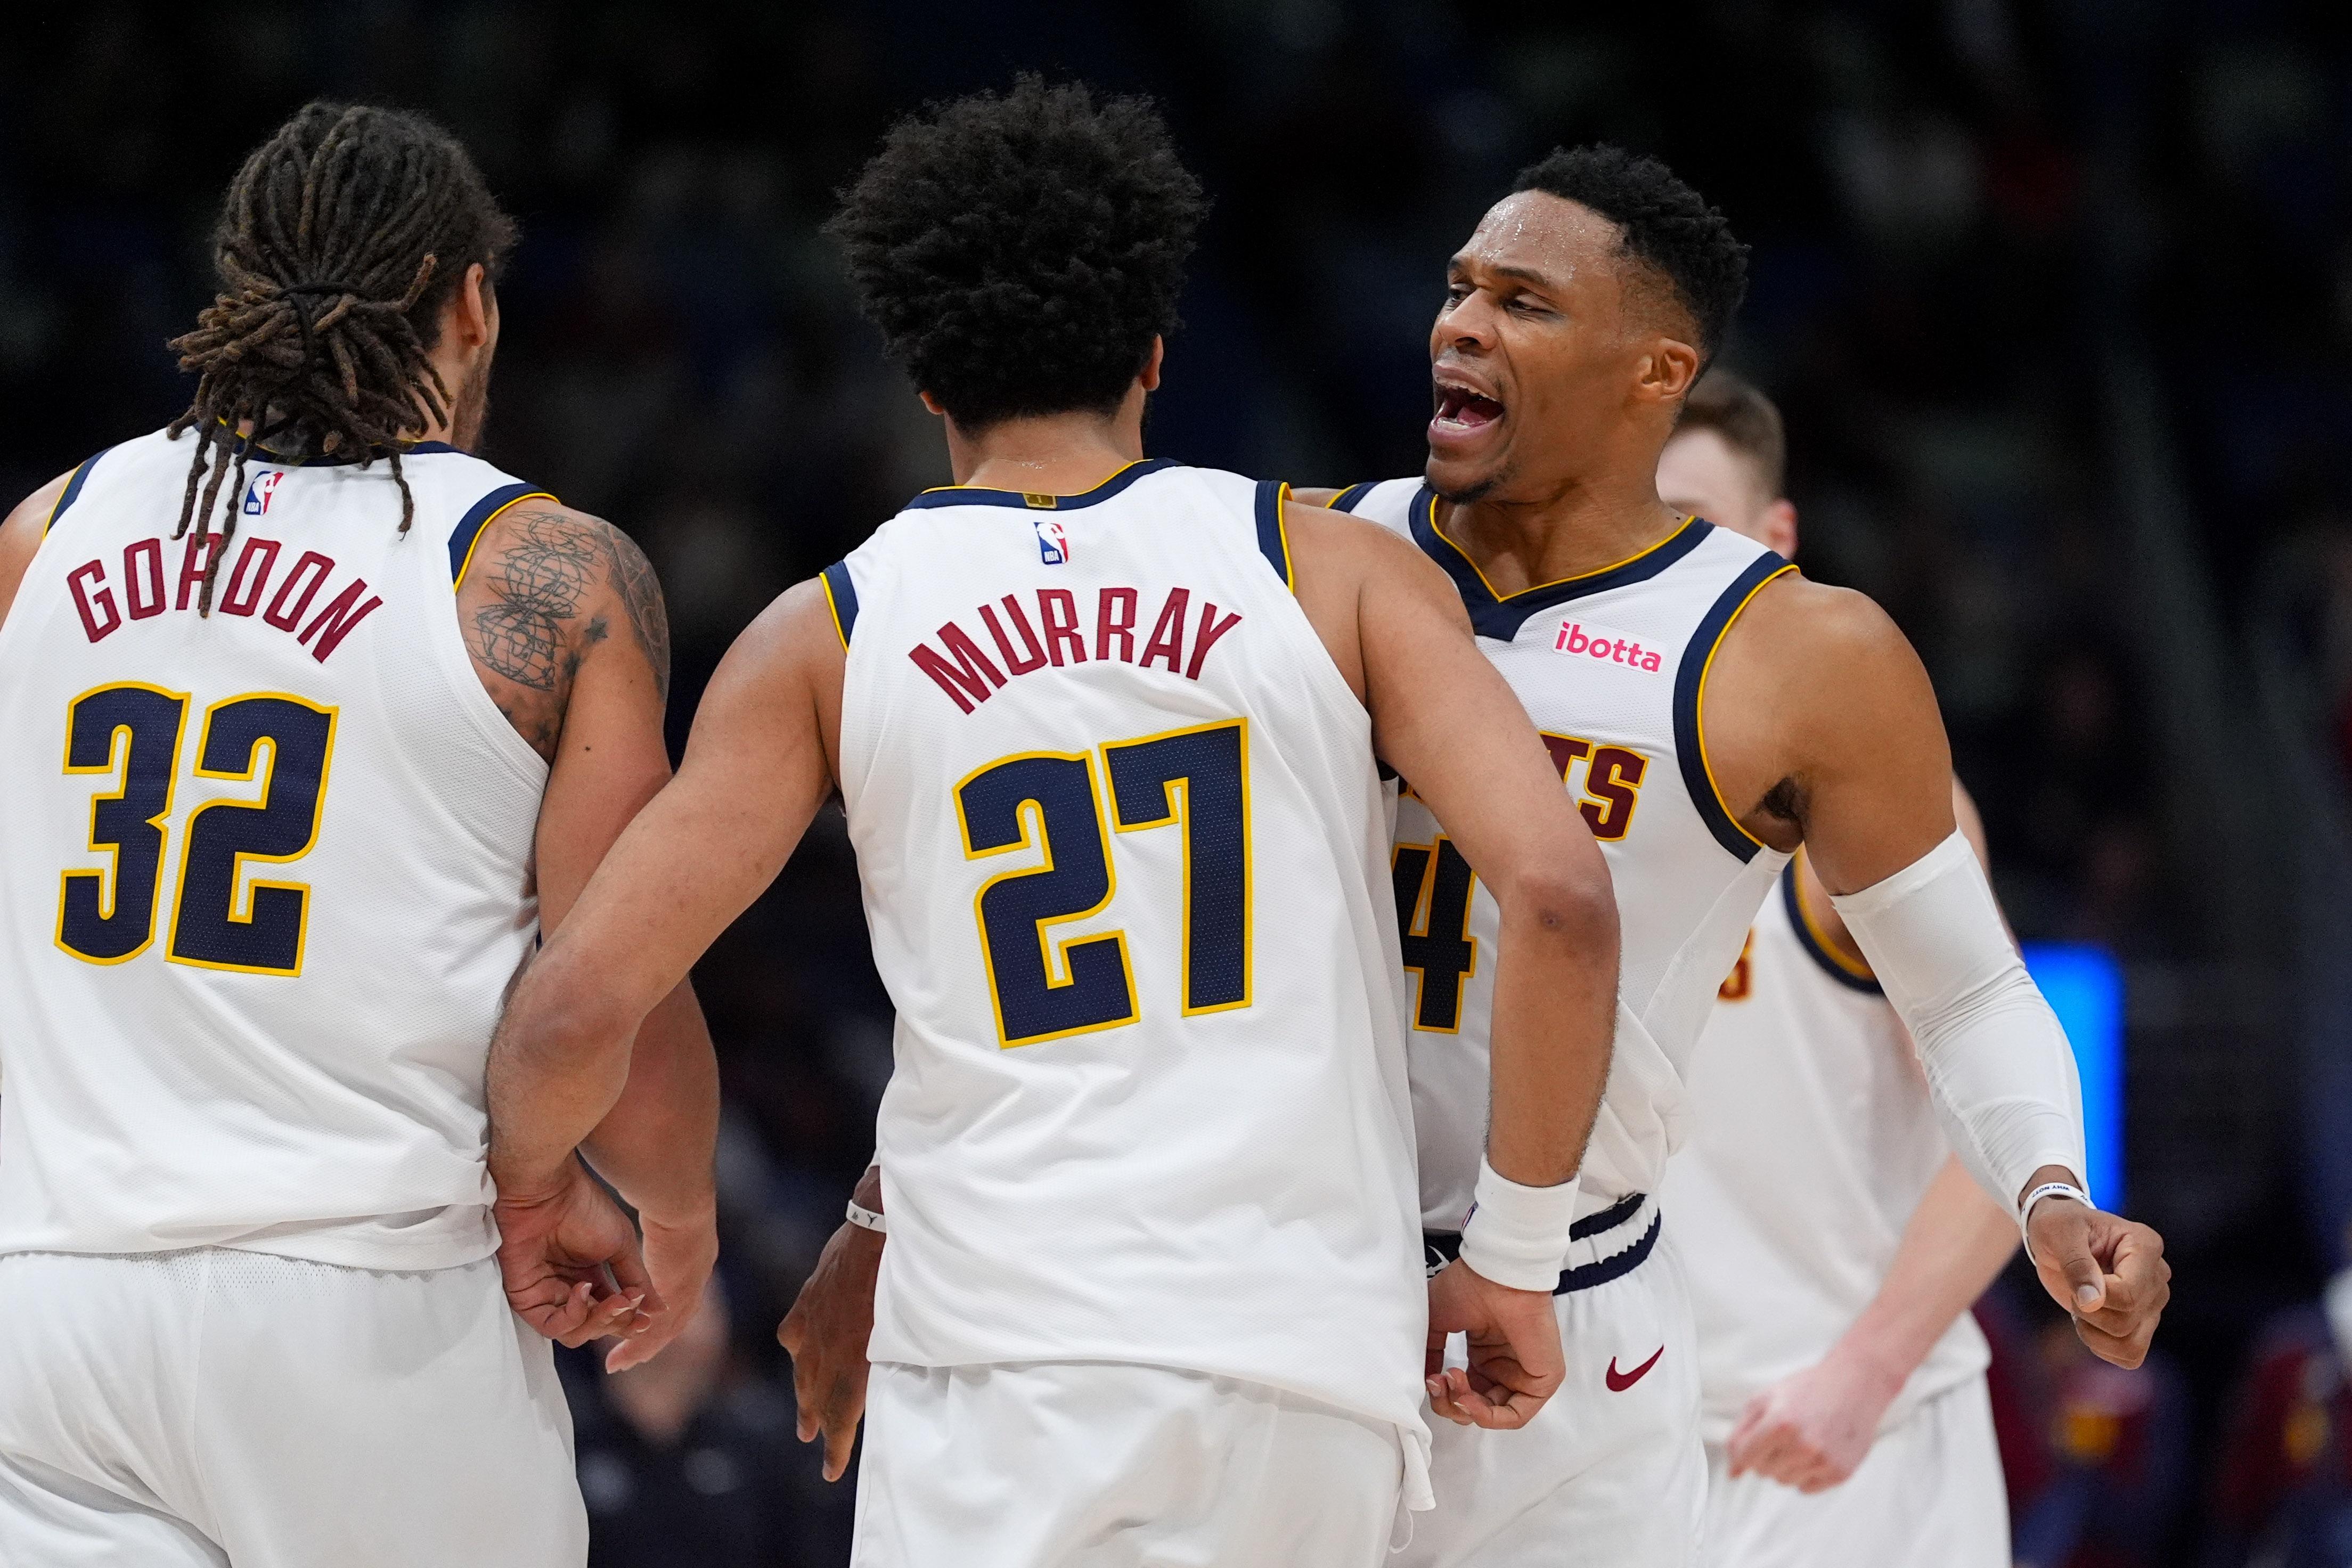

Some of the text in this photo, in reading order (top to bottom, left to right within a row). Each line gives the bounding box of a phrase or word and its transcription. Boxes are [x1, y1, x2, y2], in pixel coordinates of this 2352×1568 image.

[246, 502, 260, 512] NBA
[1044, 550, 1060, 562] NBA
[67, 530, 383, 663] GORDON
[909, 587, 1242, 714] MURRAY
[1556, 622, 1661, 672] ibotta
[53, 680, 340, 978] 32
[952, 716, 1254, 1050] 27
